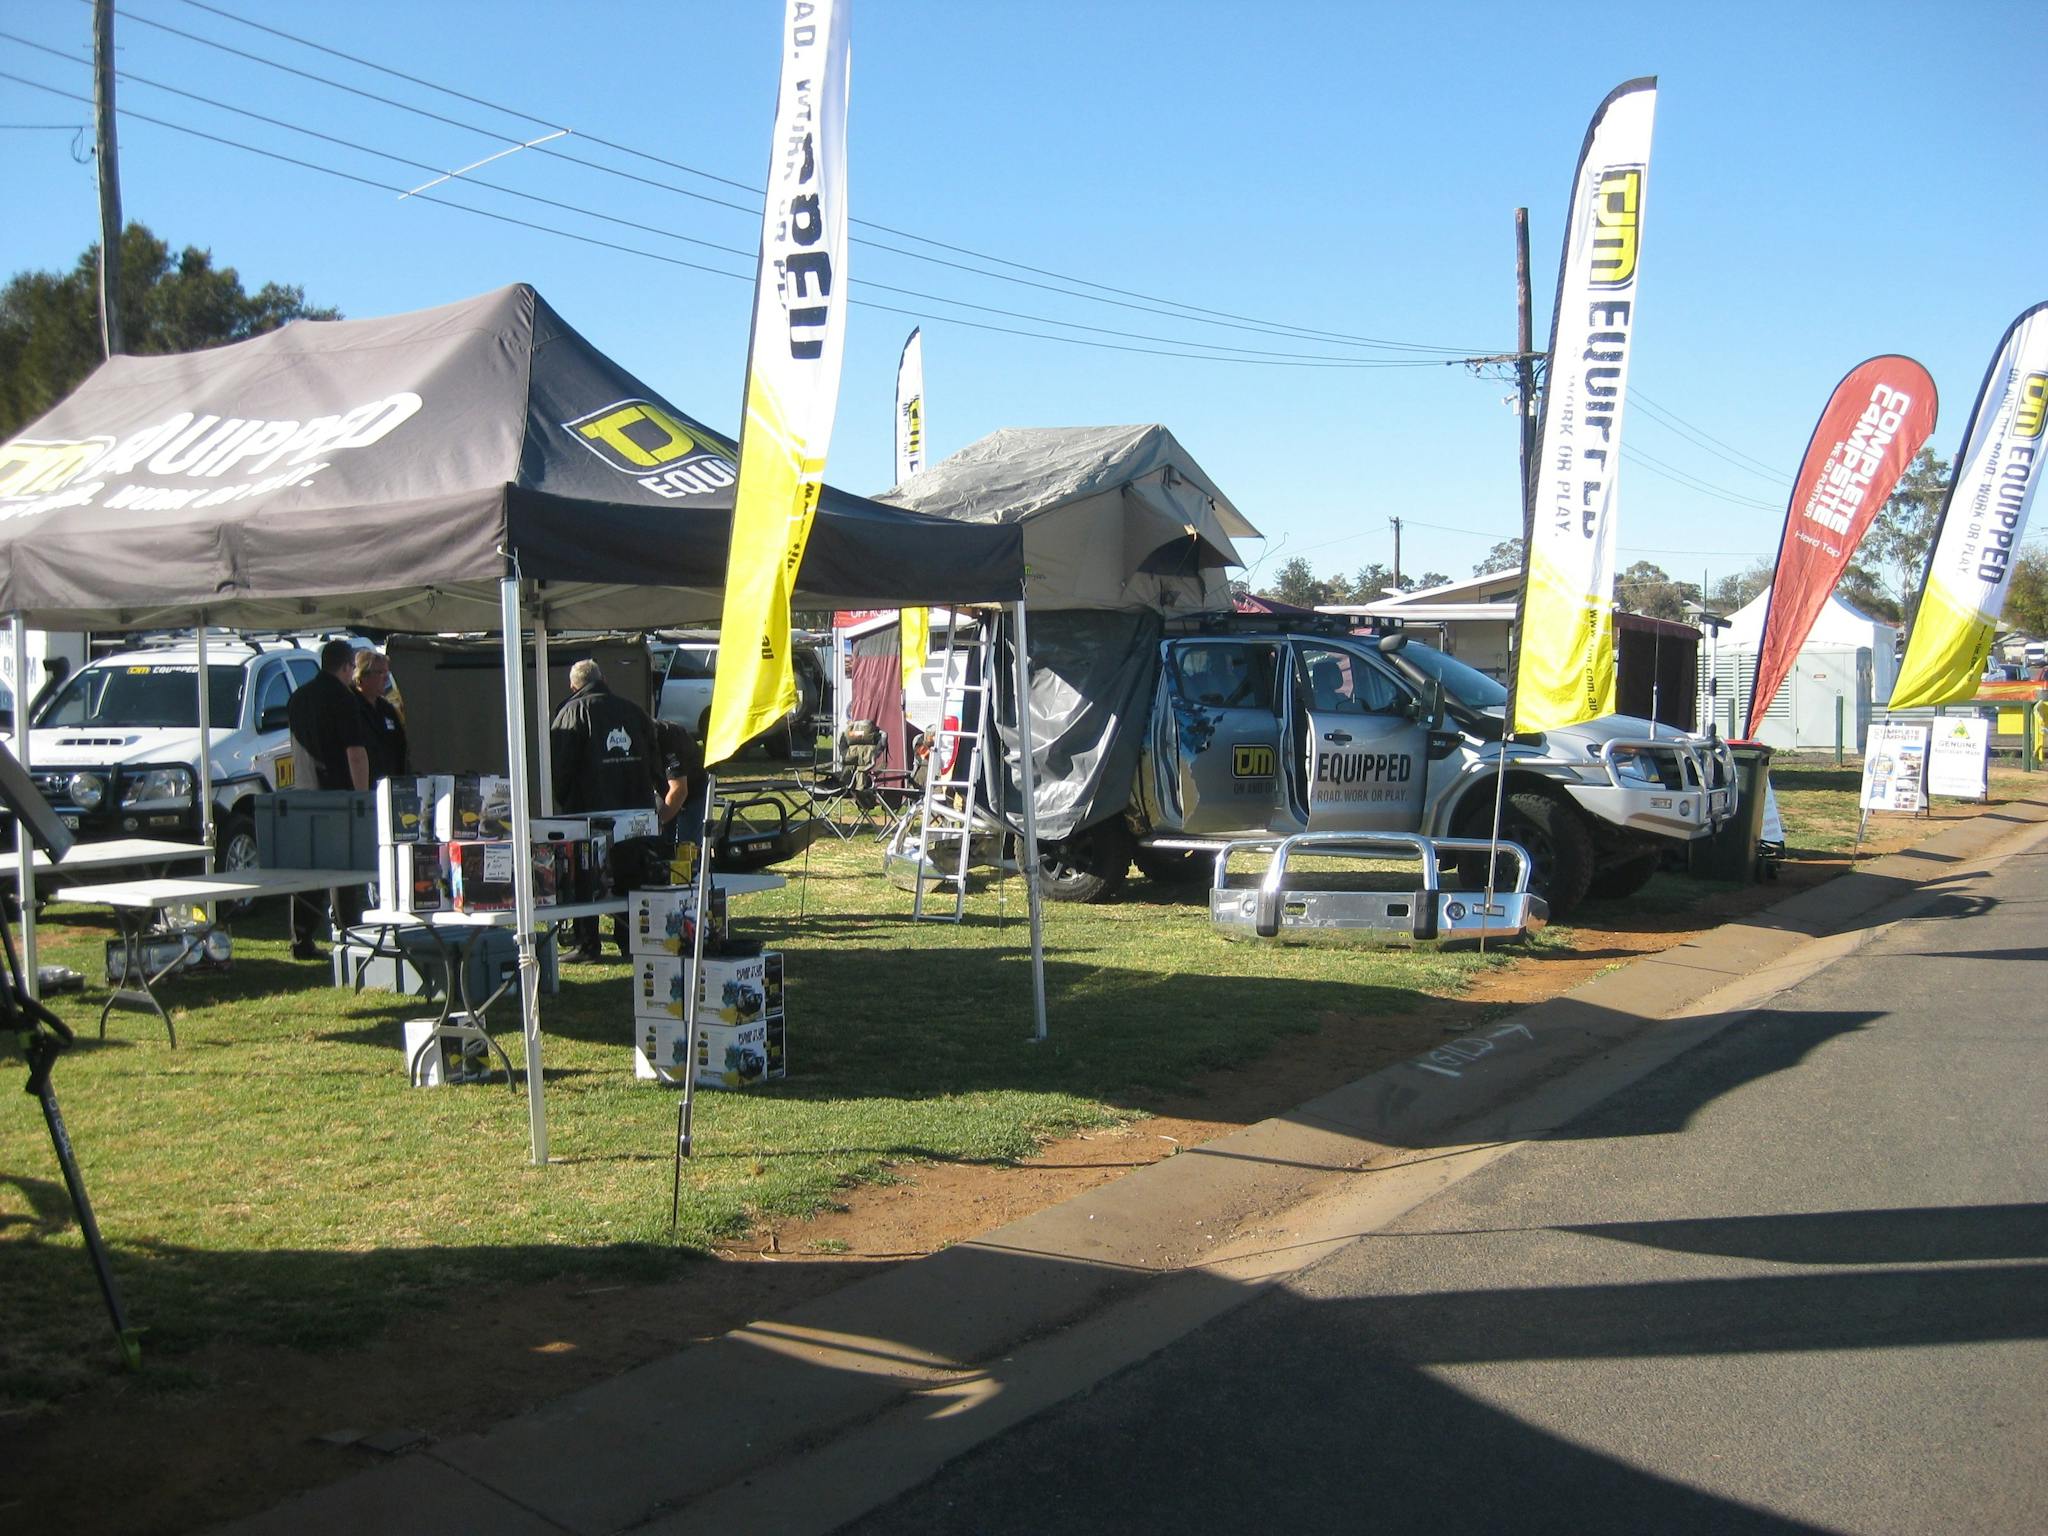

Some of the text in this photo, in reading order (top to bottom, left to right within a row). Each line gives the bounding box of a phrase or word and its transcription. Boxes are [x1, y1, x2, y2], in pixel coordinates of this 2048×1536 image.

[1812, 383, 1889, 528] CAMPSITE
[1832, 391, 1911, 537] COMPLETE
[1803, 472, 1827, 518] FURTHER
[1972, 482, 1992, 522] WORK
[1966, 524, 1982, 540] OR
[1977, 446, 2036, 585] EQUIPPED
[1794, 530, 1841, 558] Hard Top
[1938, 740, 1977, 750] GENUINE
[1317, 752, 1412, 785] EQUIPPED
[1344, 789, 1369, 801] WORK
[1371, 789, 1382, 801] OR
